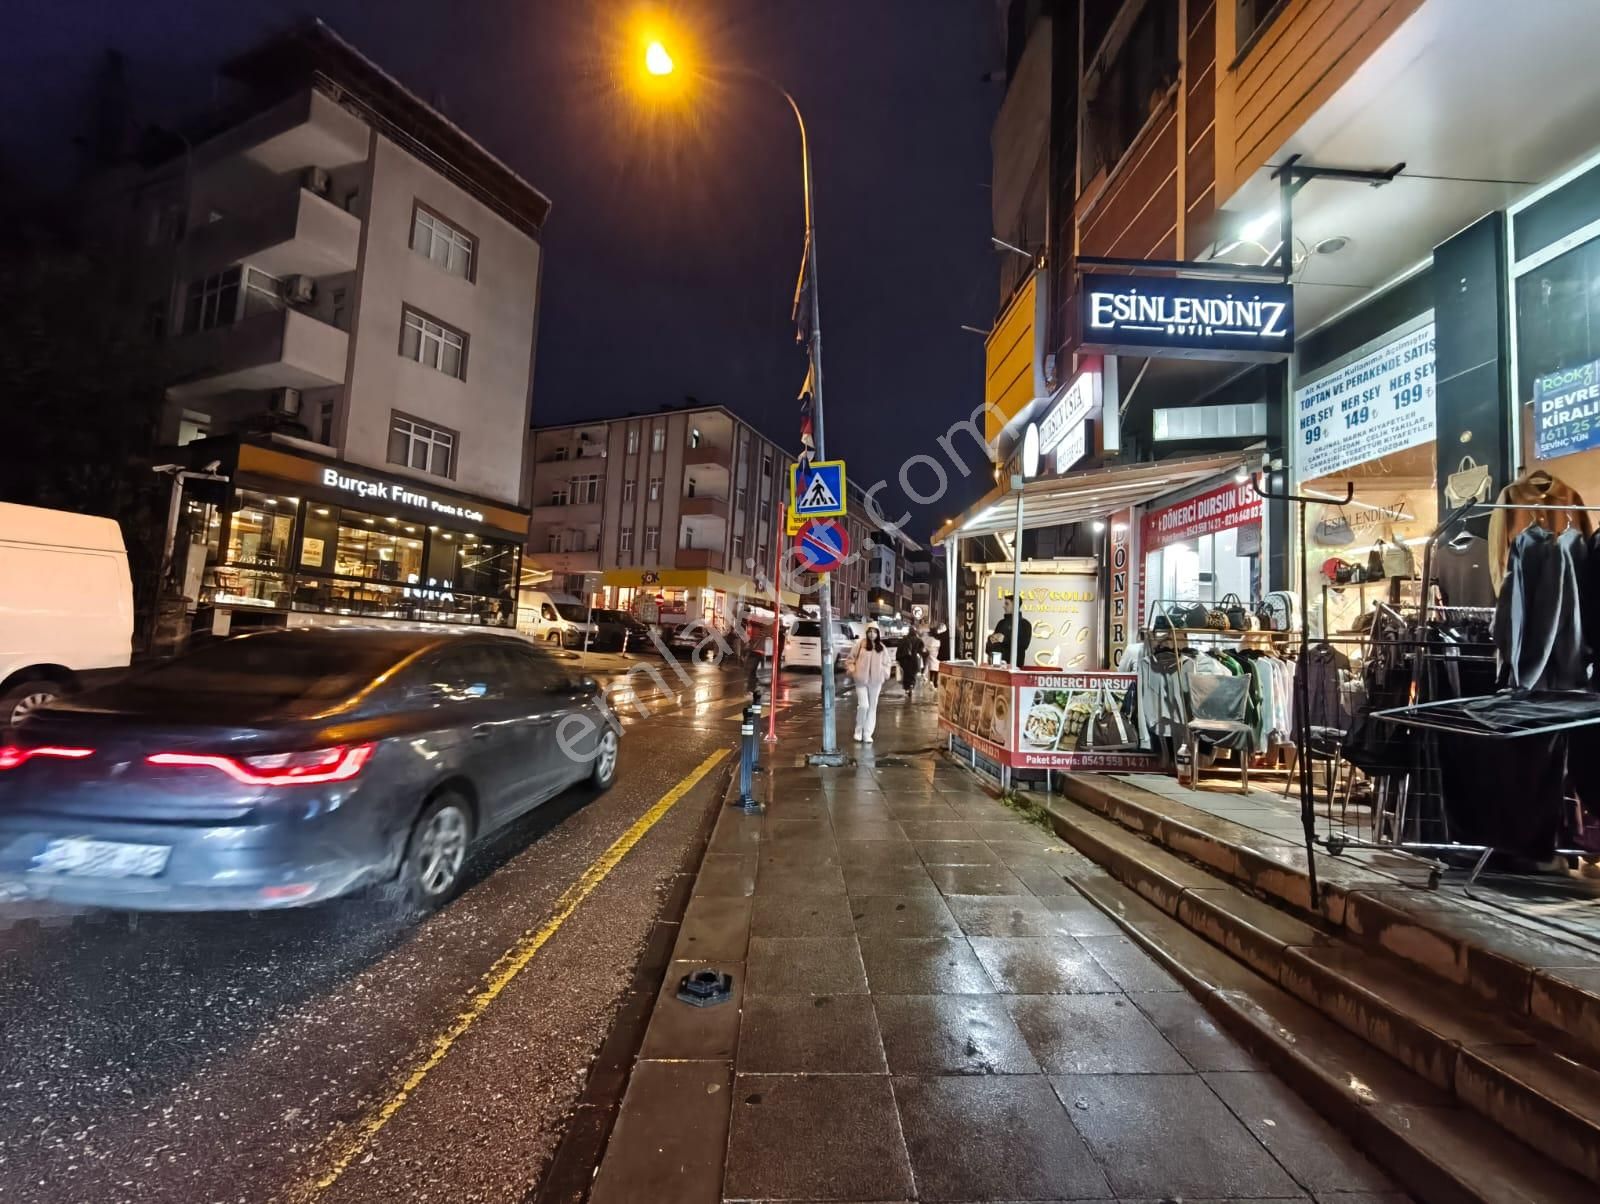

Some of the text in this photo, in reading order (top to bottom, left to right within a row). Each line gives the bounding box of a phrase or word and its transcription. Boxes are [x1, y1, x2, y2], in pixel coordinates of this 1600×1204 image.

[1090, 288, 1287, 337] ESİNLENDİNİZ
[1300, 388, 1330, 411] TOPTAN
[1333, 381, 1342, 396] VE
[1346, 354, 1400, 390] PERAKENDE
[1300, 412, 1316, 429] HER
[1341, 393, 1359, 412] HER
[1389, 371, 1410, 391] HER
[1305, 425, 1320, 445] 99
[1344, 405, 1368, 430] 149
[1393, 382, 1422, 411] 199
[1572, 420, 1590, 434] 25
[323, 468, 388, 498] Burçak
[391, 485, 428, 508] Fırın
[1163, 501, 1196, 530] DÖNERCİ
[1198, 490, 1235, 519] DURSUN
[1038, 674, 1087, 688] DÖNERCİ
[1026, 755, 1050, 764] Paket
